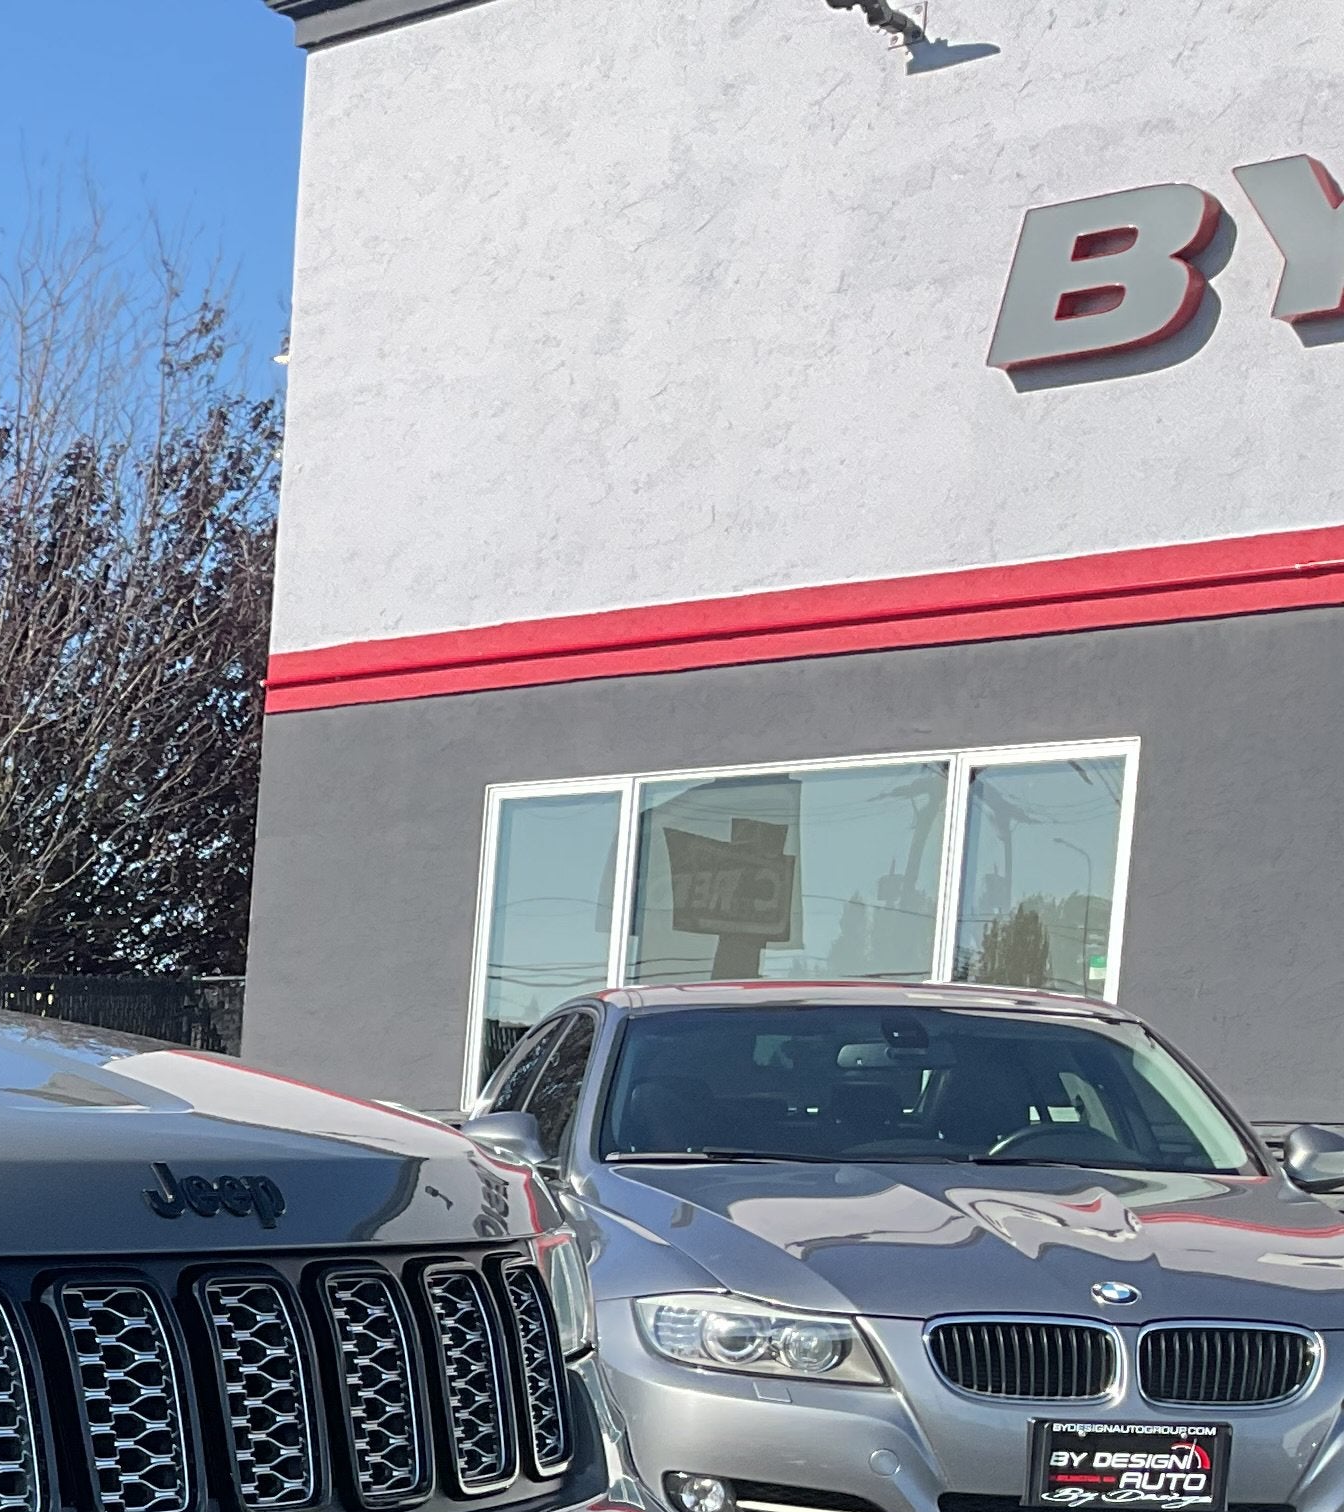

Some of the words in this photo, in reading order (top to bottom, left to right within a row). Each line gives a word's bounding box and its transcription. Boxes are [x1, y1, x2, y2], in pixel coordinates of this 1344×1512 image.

[142, 1161, 286, 1230] Jeep
[1052, 1423, 1217, 1437] BYDESIGNAUTOGROUP.COM
[1049, 1451, 1088, 1467] BY
[1093, 1453, 1192, 1469] DESIGN
[1119, 1472, 1206, 1490] AUTO
[1041, 1487, 1098, 1508] By
